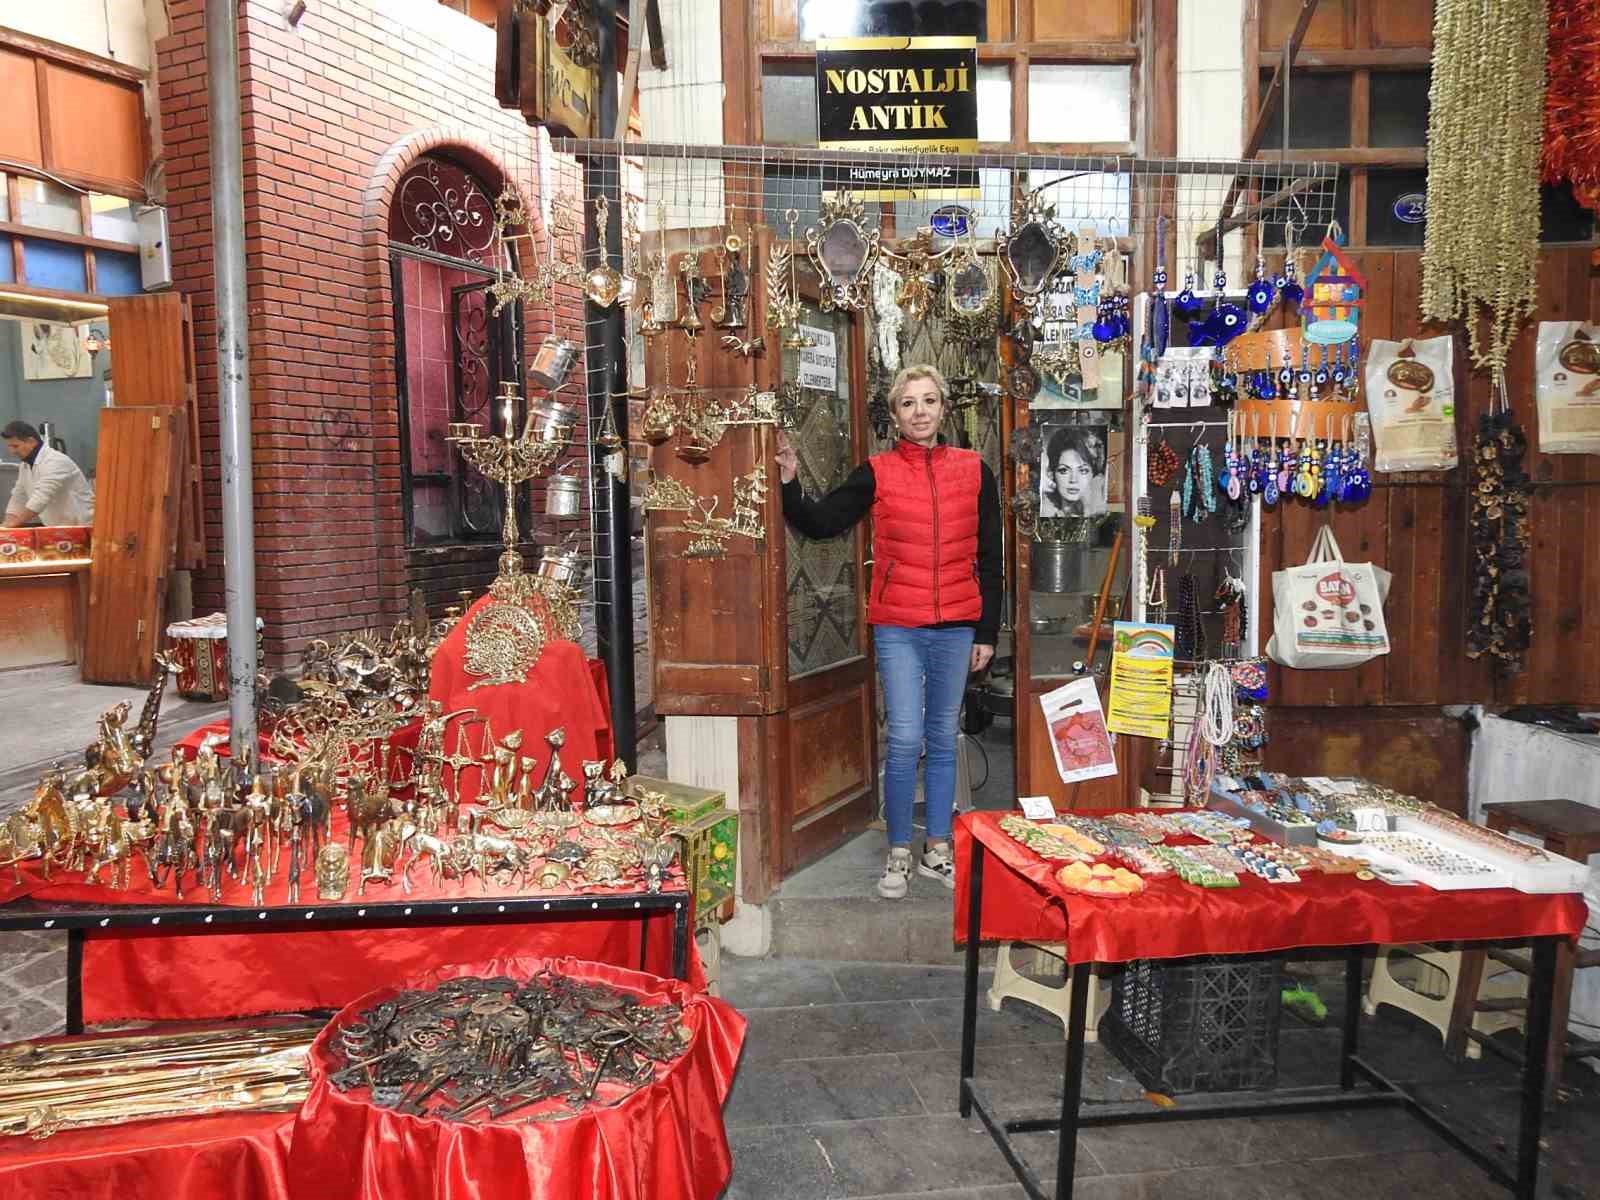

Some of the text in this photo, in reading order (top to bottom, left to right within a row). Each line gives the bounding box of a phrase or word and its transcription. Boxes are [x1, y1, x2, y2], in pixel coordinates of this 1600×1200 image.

[551, 65, 572, 108] WC
[825, 61, 970, 94] NOSTALJİ
[849, 99, 949, 131] ANTİK
[849, 166, 952, 181] Hümeyra DUYMAZ
